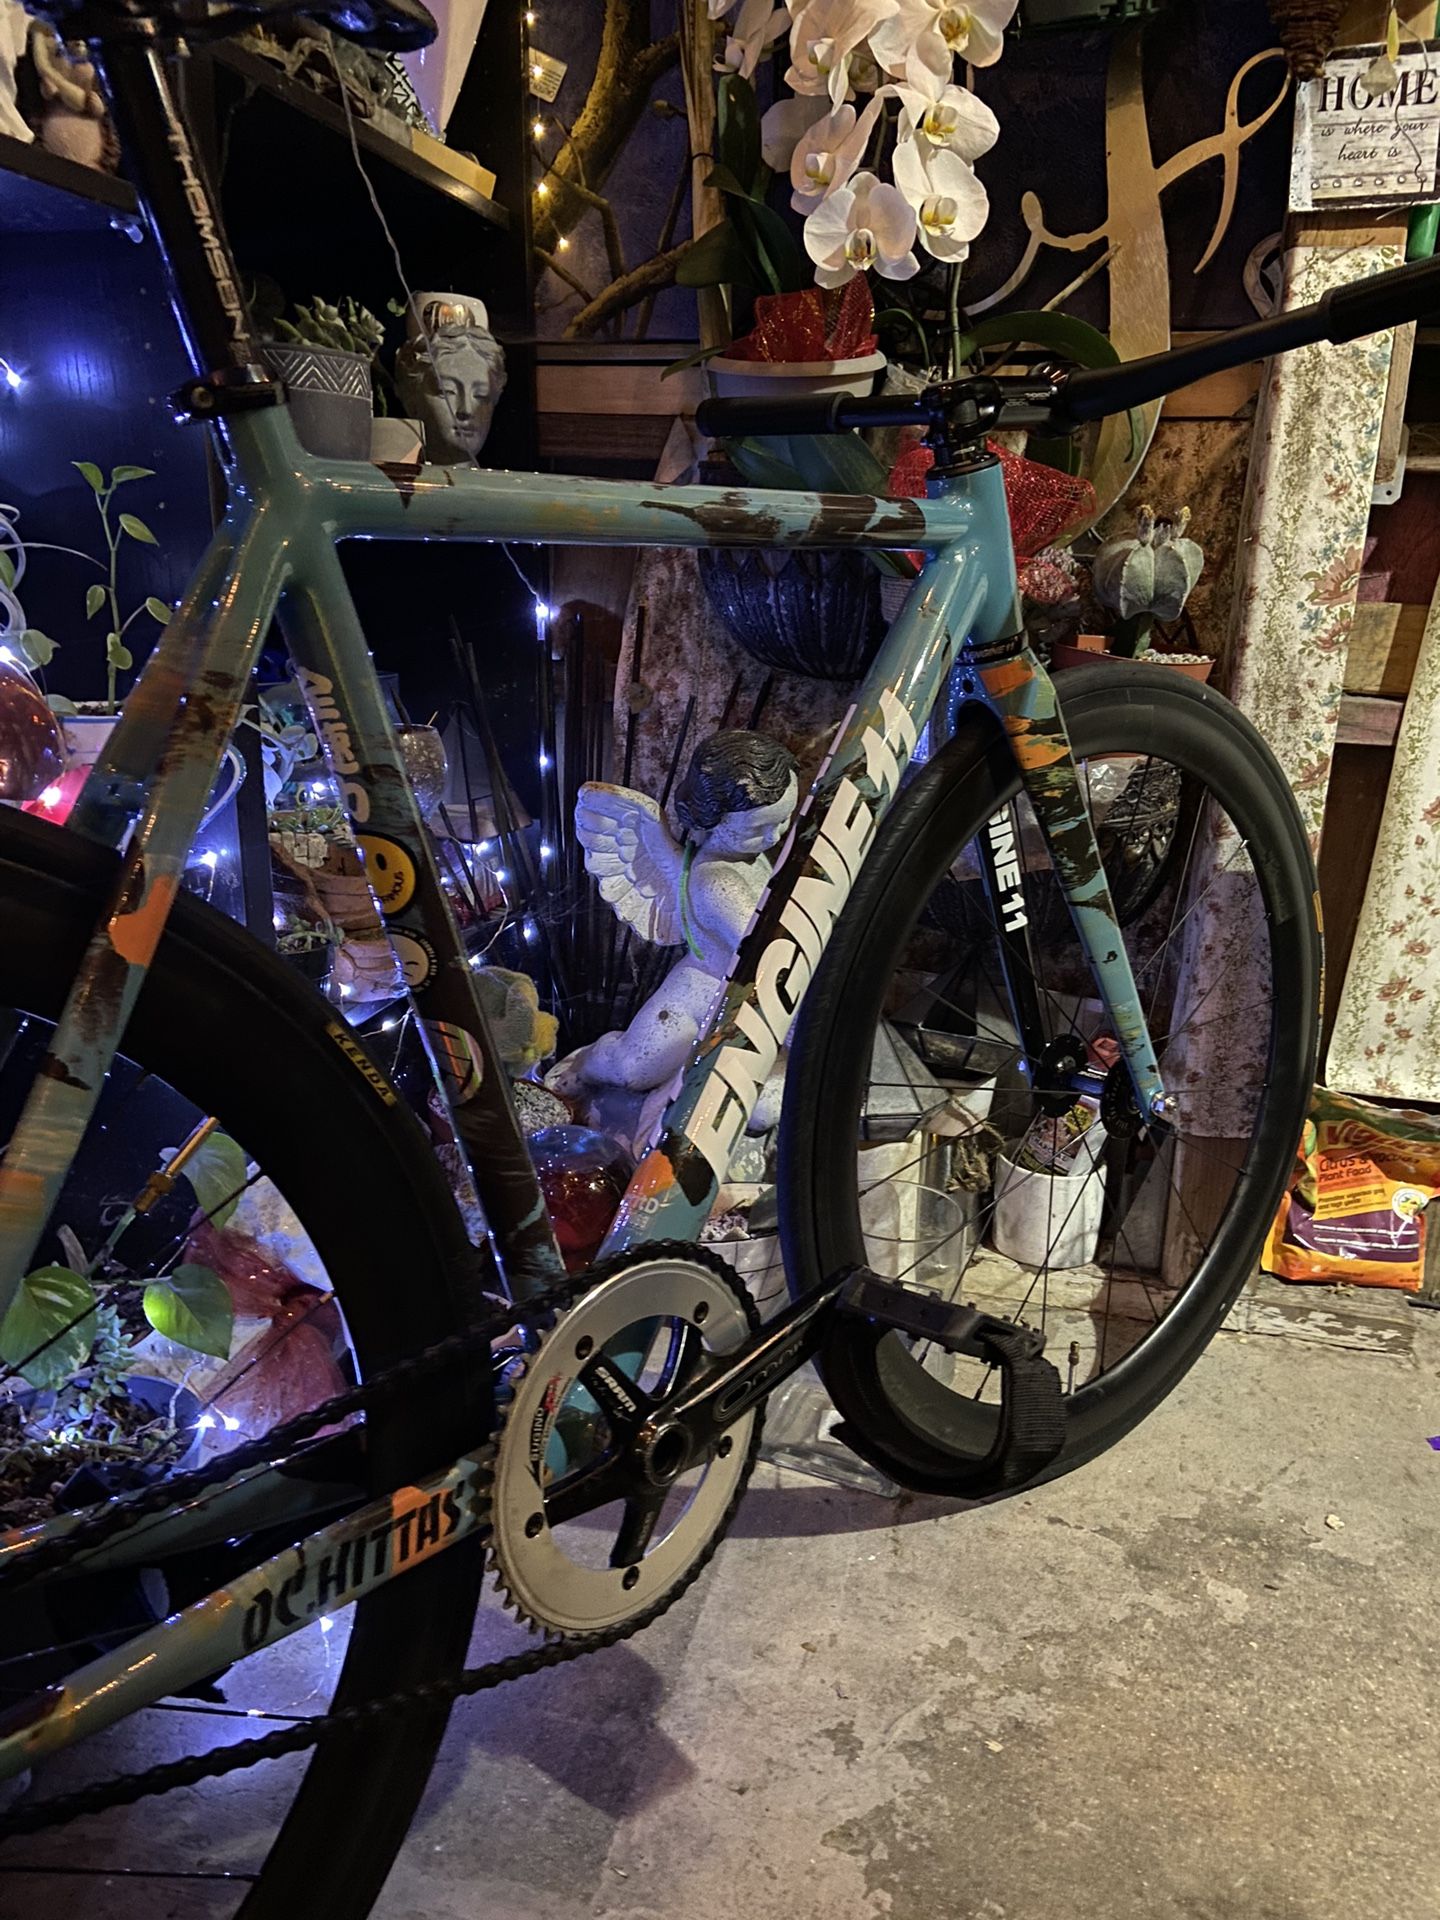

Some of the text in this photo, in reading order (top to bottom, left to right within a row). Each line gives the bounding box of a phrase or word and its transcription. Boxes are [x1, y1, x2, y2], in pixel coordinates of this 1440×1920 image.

[1318, 68, 1438, 112] HOME
[1321, 117, 1429, 140] is where your
[1338, 144, 1400, 161] heart is
[168, 121, 250, 340] THOMSON
[333, 1033, 391, 1097] KENDA
[1320, 1164, 1372, 1182] Plant Food
[595, 1366, 637, 1412] SRAM
